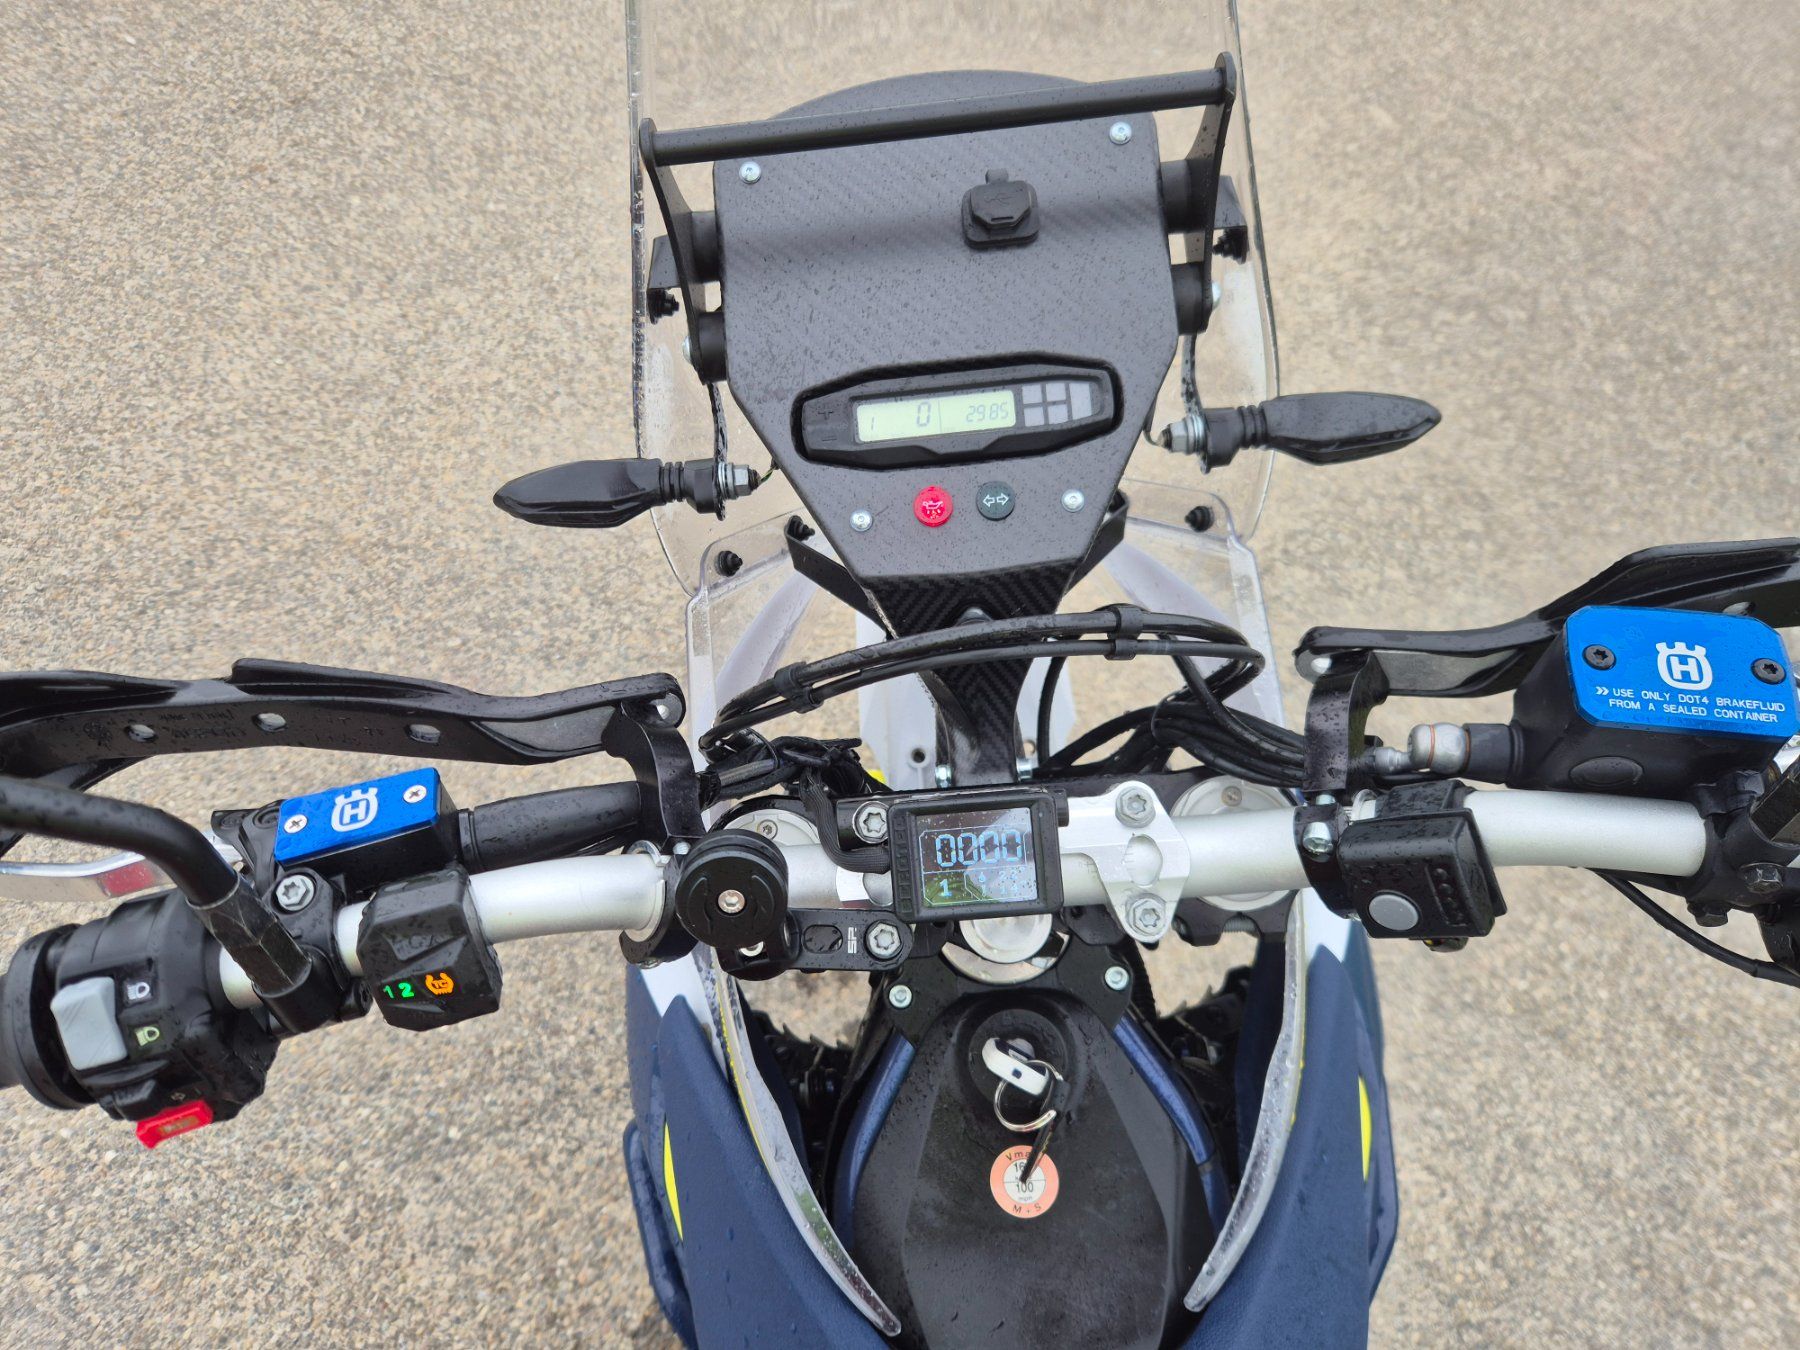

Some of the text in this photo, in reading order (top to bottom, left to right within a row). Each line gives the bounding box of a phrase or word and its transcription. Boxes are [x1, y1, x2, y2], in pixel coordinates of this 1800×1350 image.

[1609, 698, 1779, 722] FROM A SEALED CONTAINER
[1613, 687, 1786, 712] USE ONLY DOT4 BRAKEFLUID
